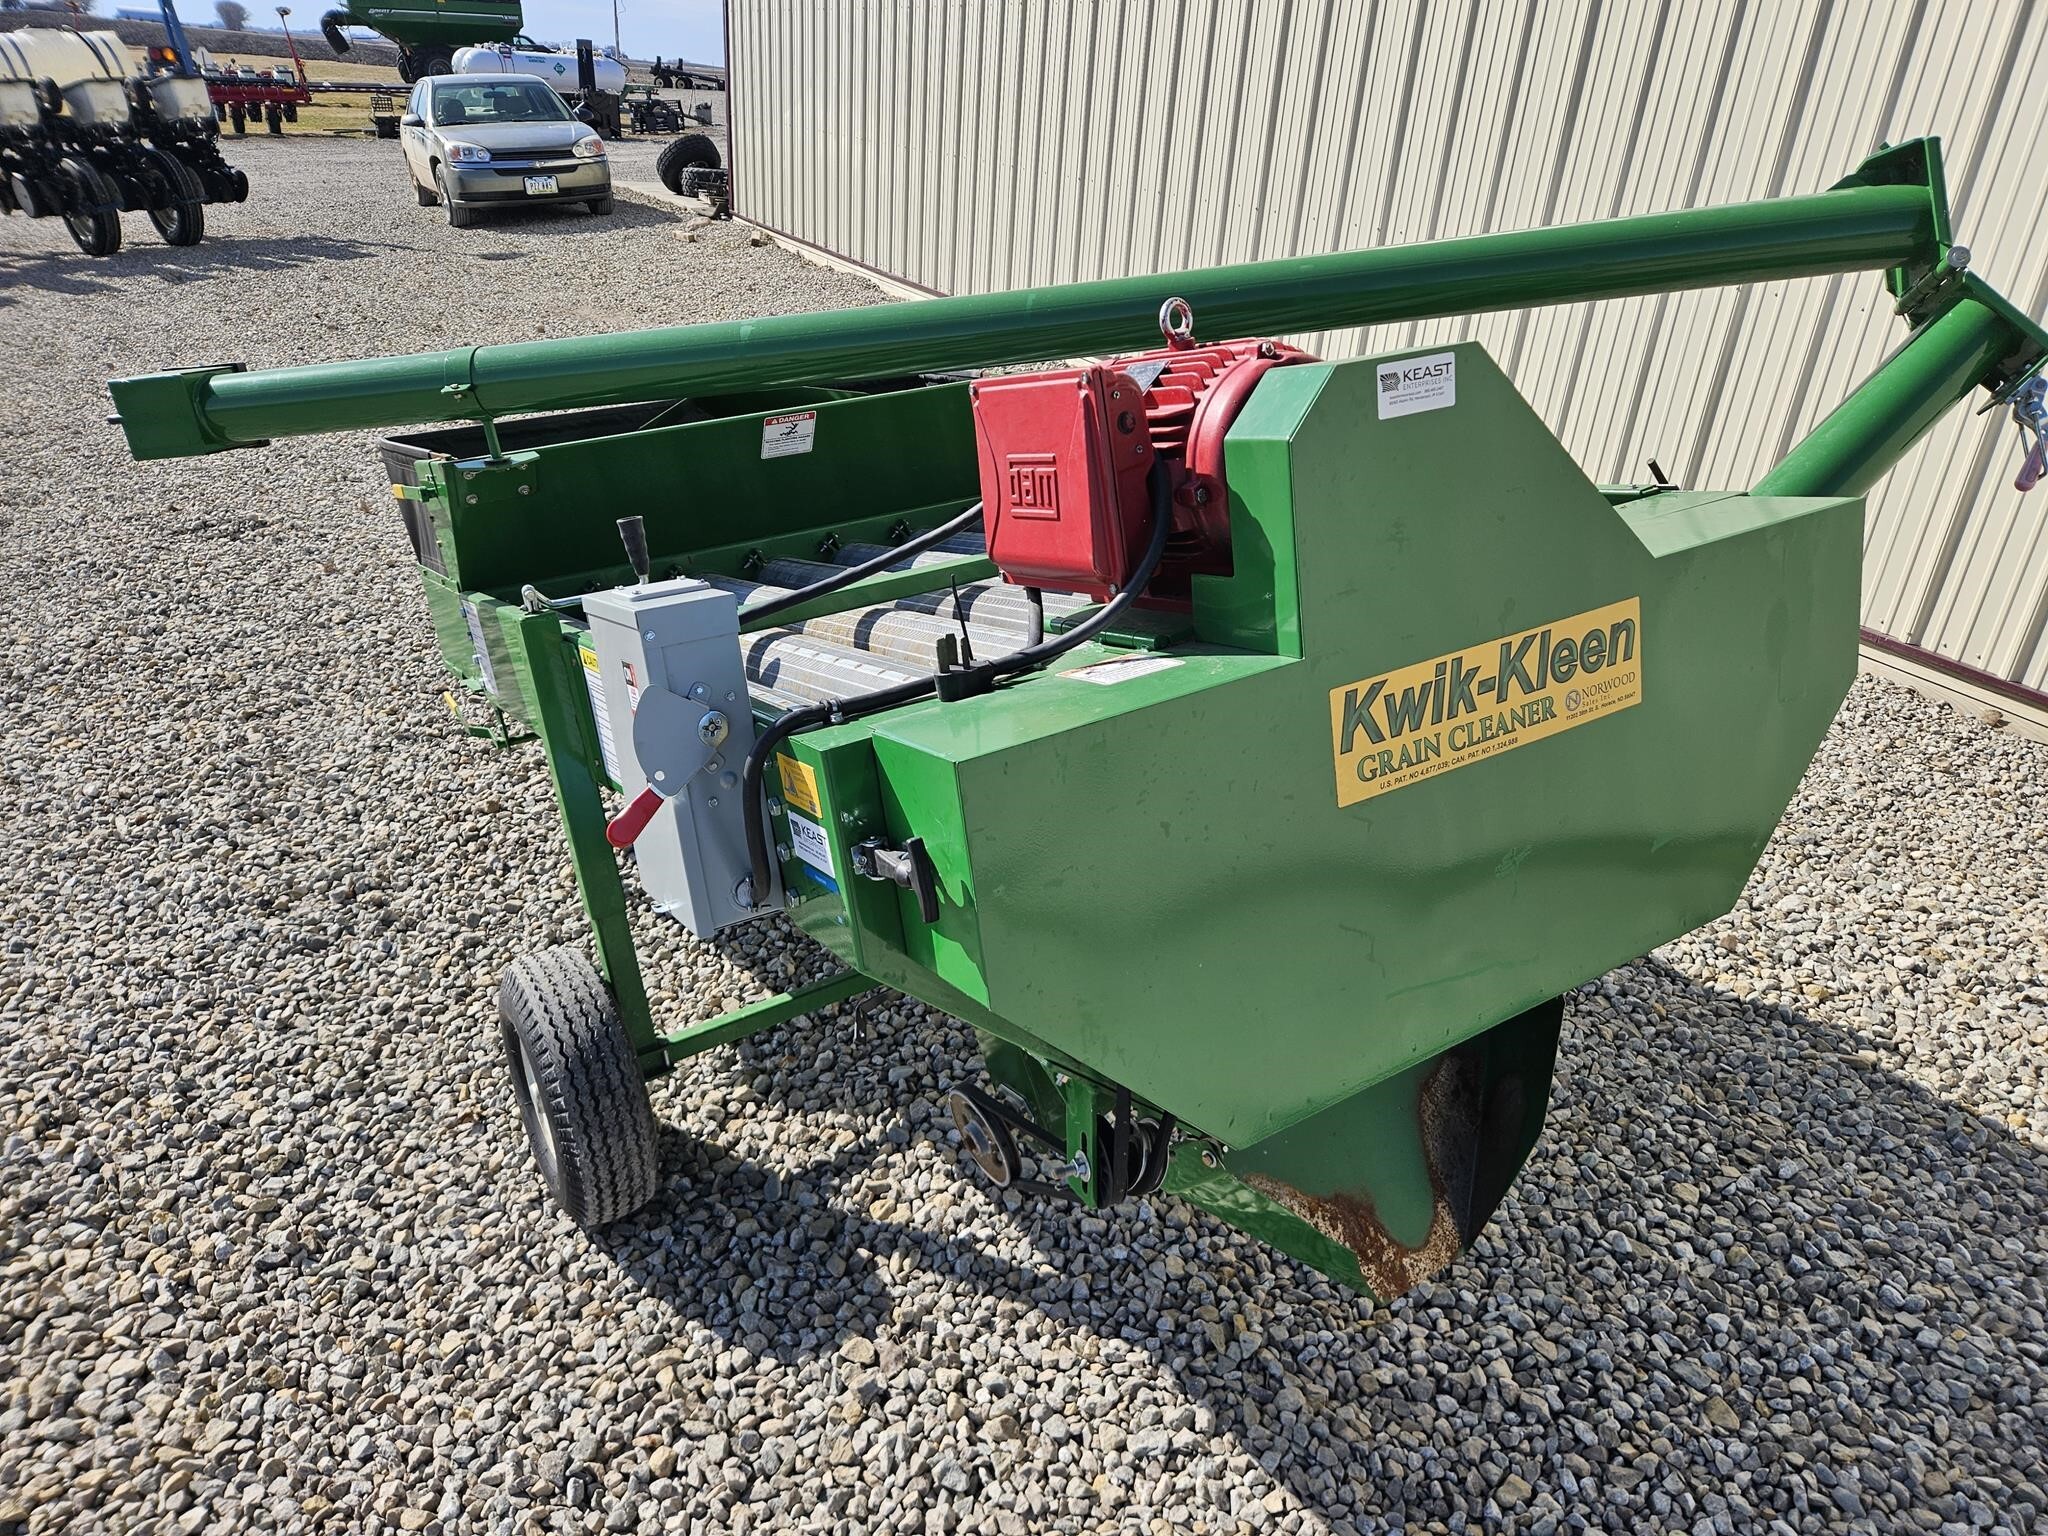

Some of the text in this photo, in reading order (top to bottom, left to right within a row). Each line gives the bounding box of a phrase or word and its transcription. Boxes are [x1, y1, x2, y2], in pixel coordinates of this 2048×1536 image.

[1403, 362, 1452, 382] KEAST
[1403, 378, 1441, 390] ENTERPRISES
[778, 414, 810, 423] DANGER
[1340, 618, 1636, 755] Kwik-Kleen
[1582, 672, 1636, 699] NORWOOD
[1582, 698, 1599, 708] Sales
[1356, 695, 1557, 783] GRAIN CLEANER
[1380, 780, 1393, 790] U.S.
[1394, 776, 1408, 785] PAT.
[1408, 770, 1420, 780] NO
[1420, 760, 1450, 776] 4,877,039;
[1451, 756, 1466, 766] CAN.
[1467, 750, 1480, 760] PAT.
[1481, 745, 1491, 754] NO
[801, 825, 826, 845] KEAST
